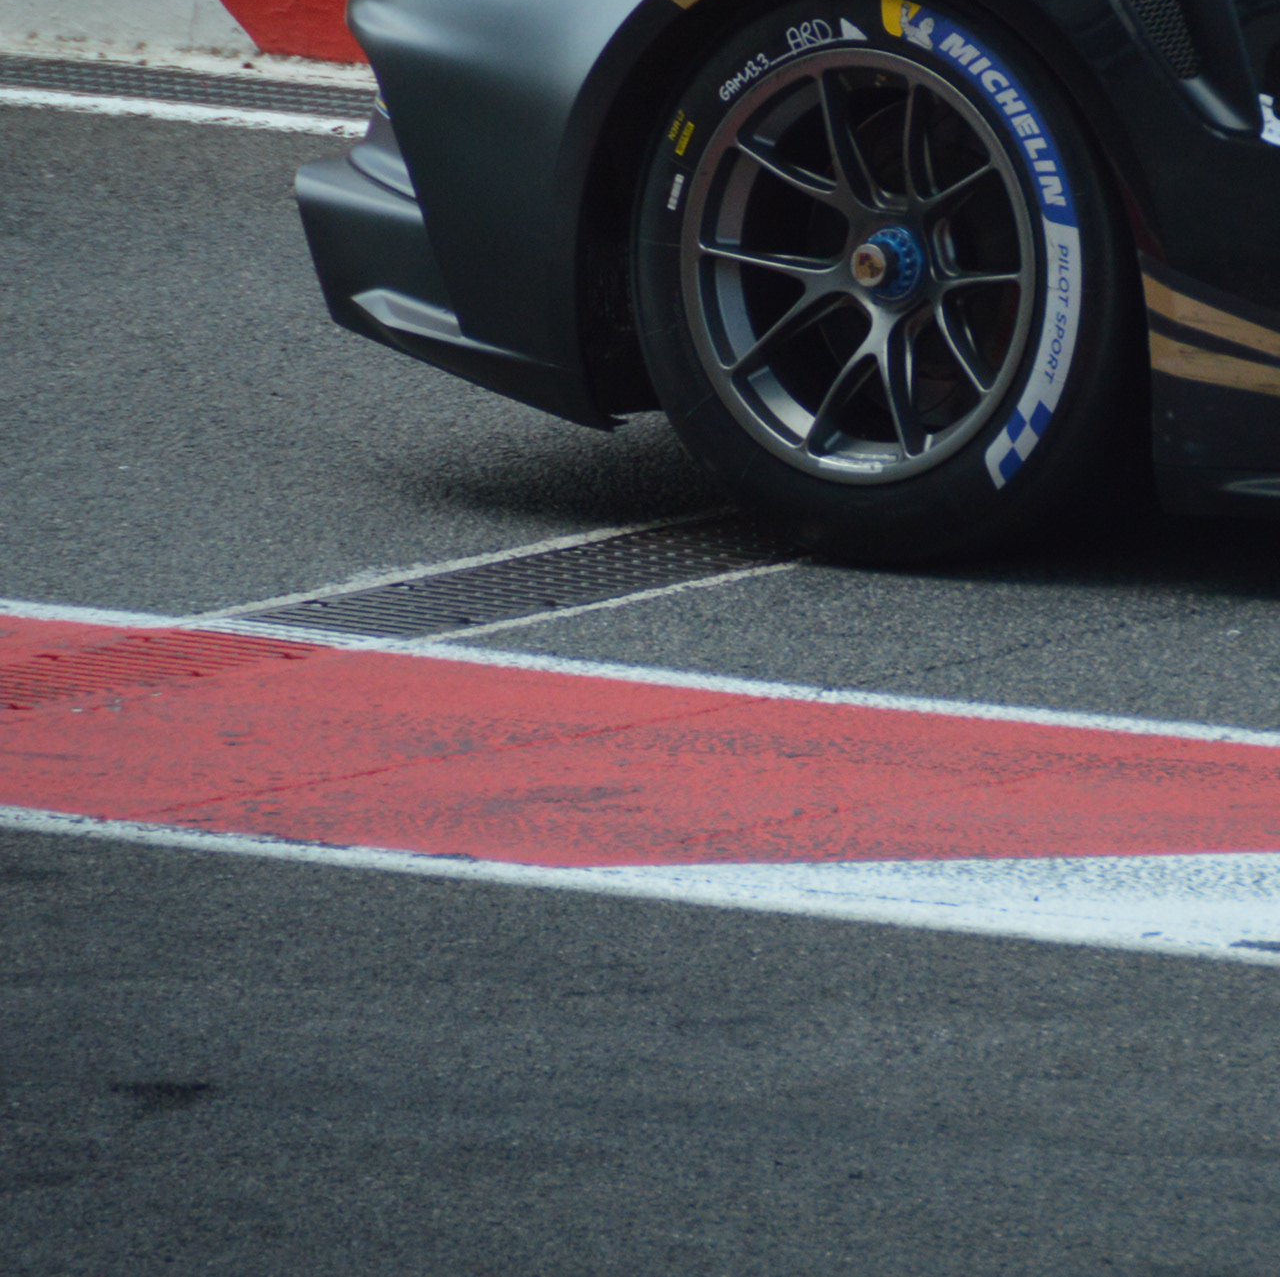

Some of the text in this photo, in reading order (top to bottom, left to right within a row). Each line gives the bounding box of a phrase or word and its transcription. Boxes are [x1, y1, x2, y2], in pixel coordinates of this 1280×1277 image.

[939, 32, 1067, 207] MICHELIN
[1044, 243, 1070, 385] PILOT SPORT
